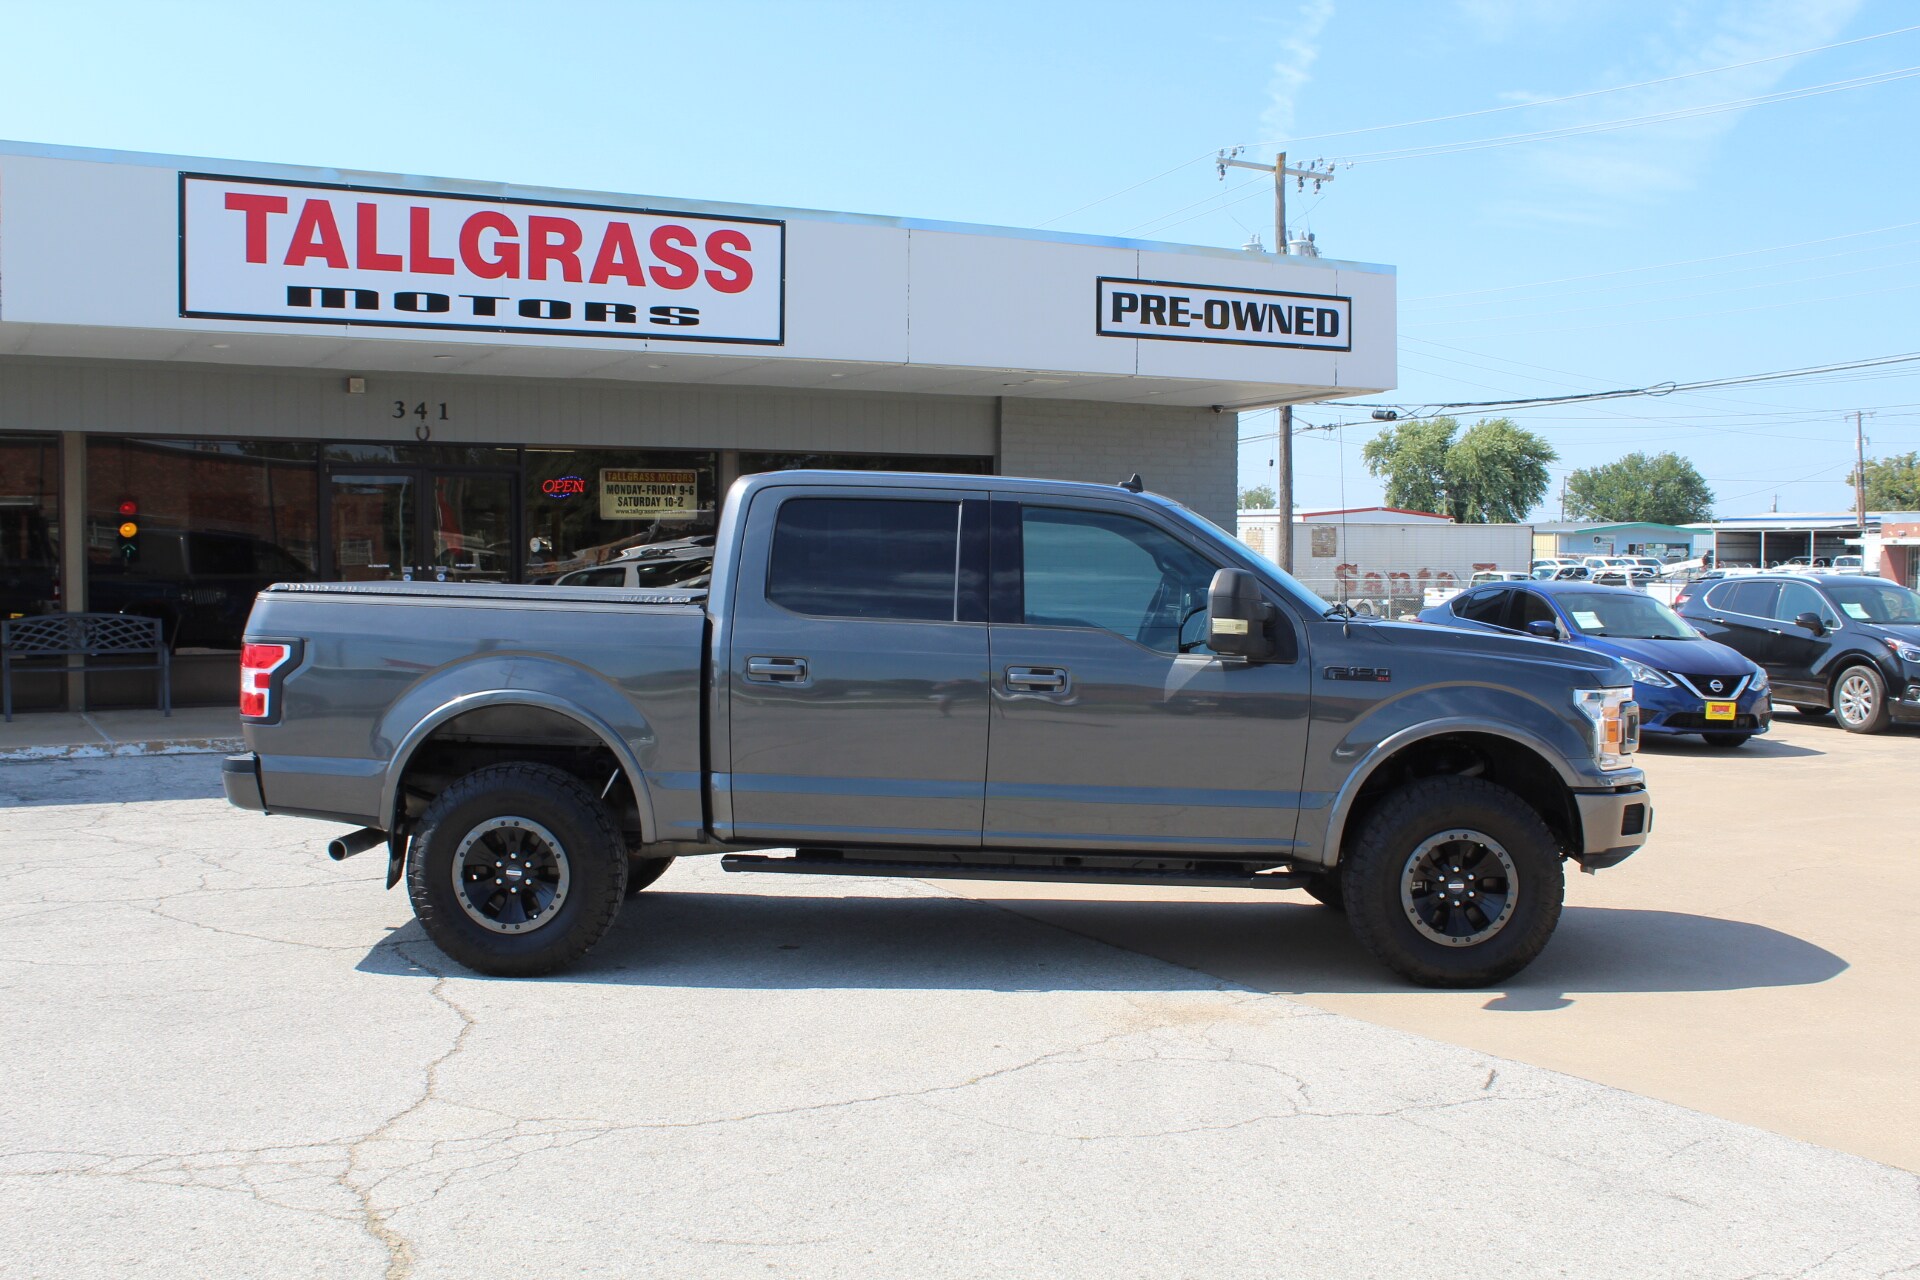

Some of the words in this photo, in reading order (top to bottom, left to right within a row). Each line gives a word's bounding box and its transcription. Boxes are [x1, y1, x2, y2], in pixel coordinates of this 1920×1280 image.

[224, 193, 753, 293] TALLGRASS
[286, 285, 699, 326] MOTORS
[1111, 291, 1339, 338] PRE-OWNED
[392, 401, 448, 420] 341
[607, 472, 655, 481] TALLGRASS
[658, 473, 694, 482] MOTORS
[542, 479, 584, 493] OPEN
[606, 484, 676, 495] MONDAY-FRIDAY
[679, 485, 694, 495] 9-6
[618, 496, 661, 507] SATURDAY
[665, 497, 683, 507] 10-2
